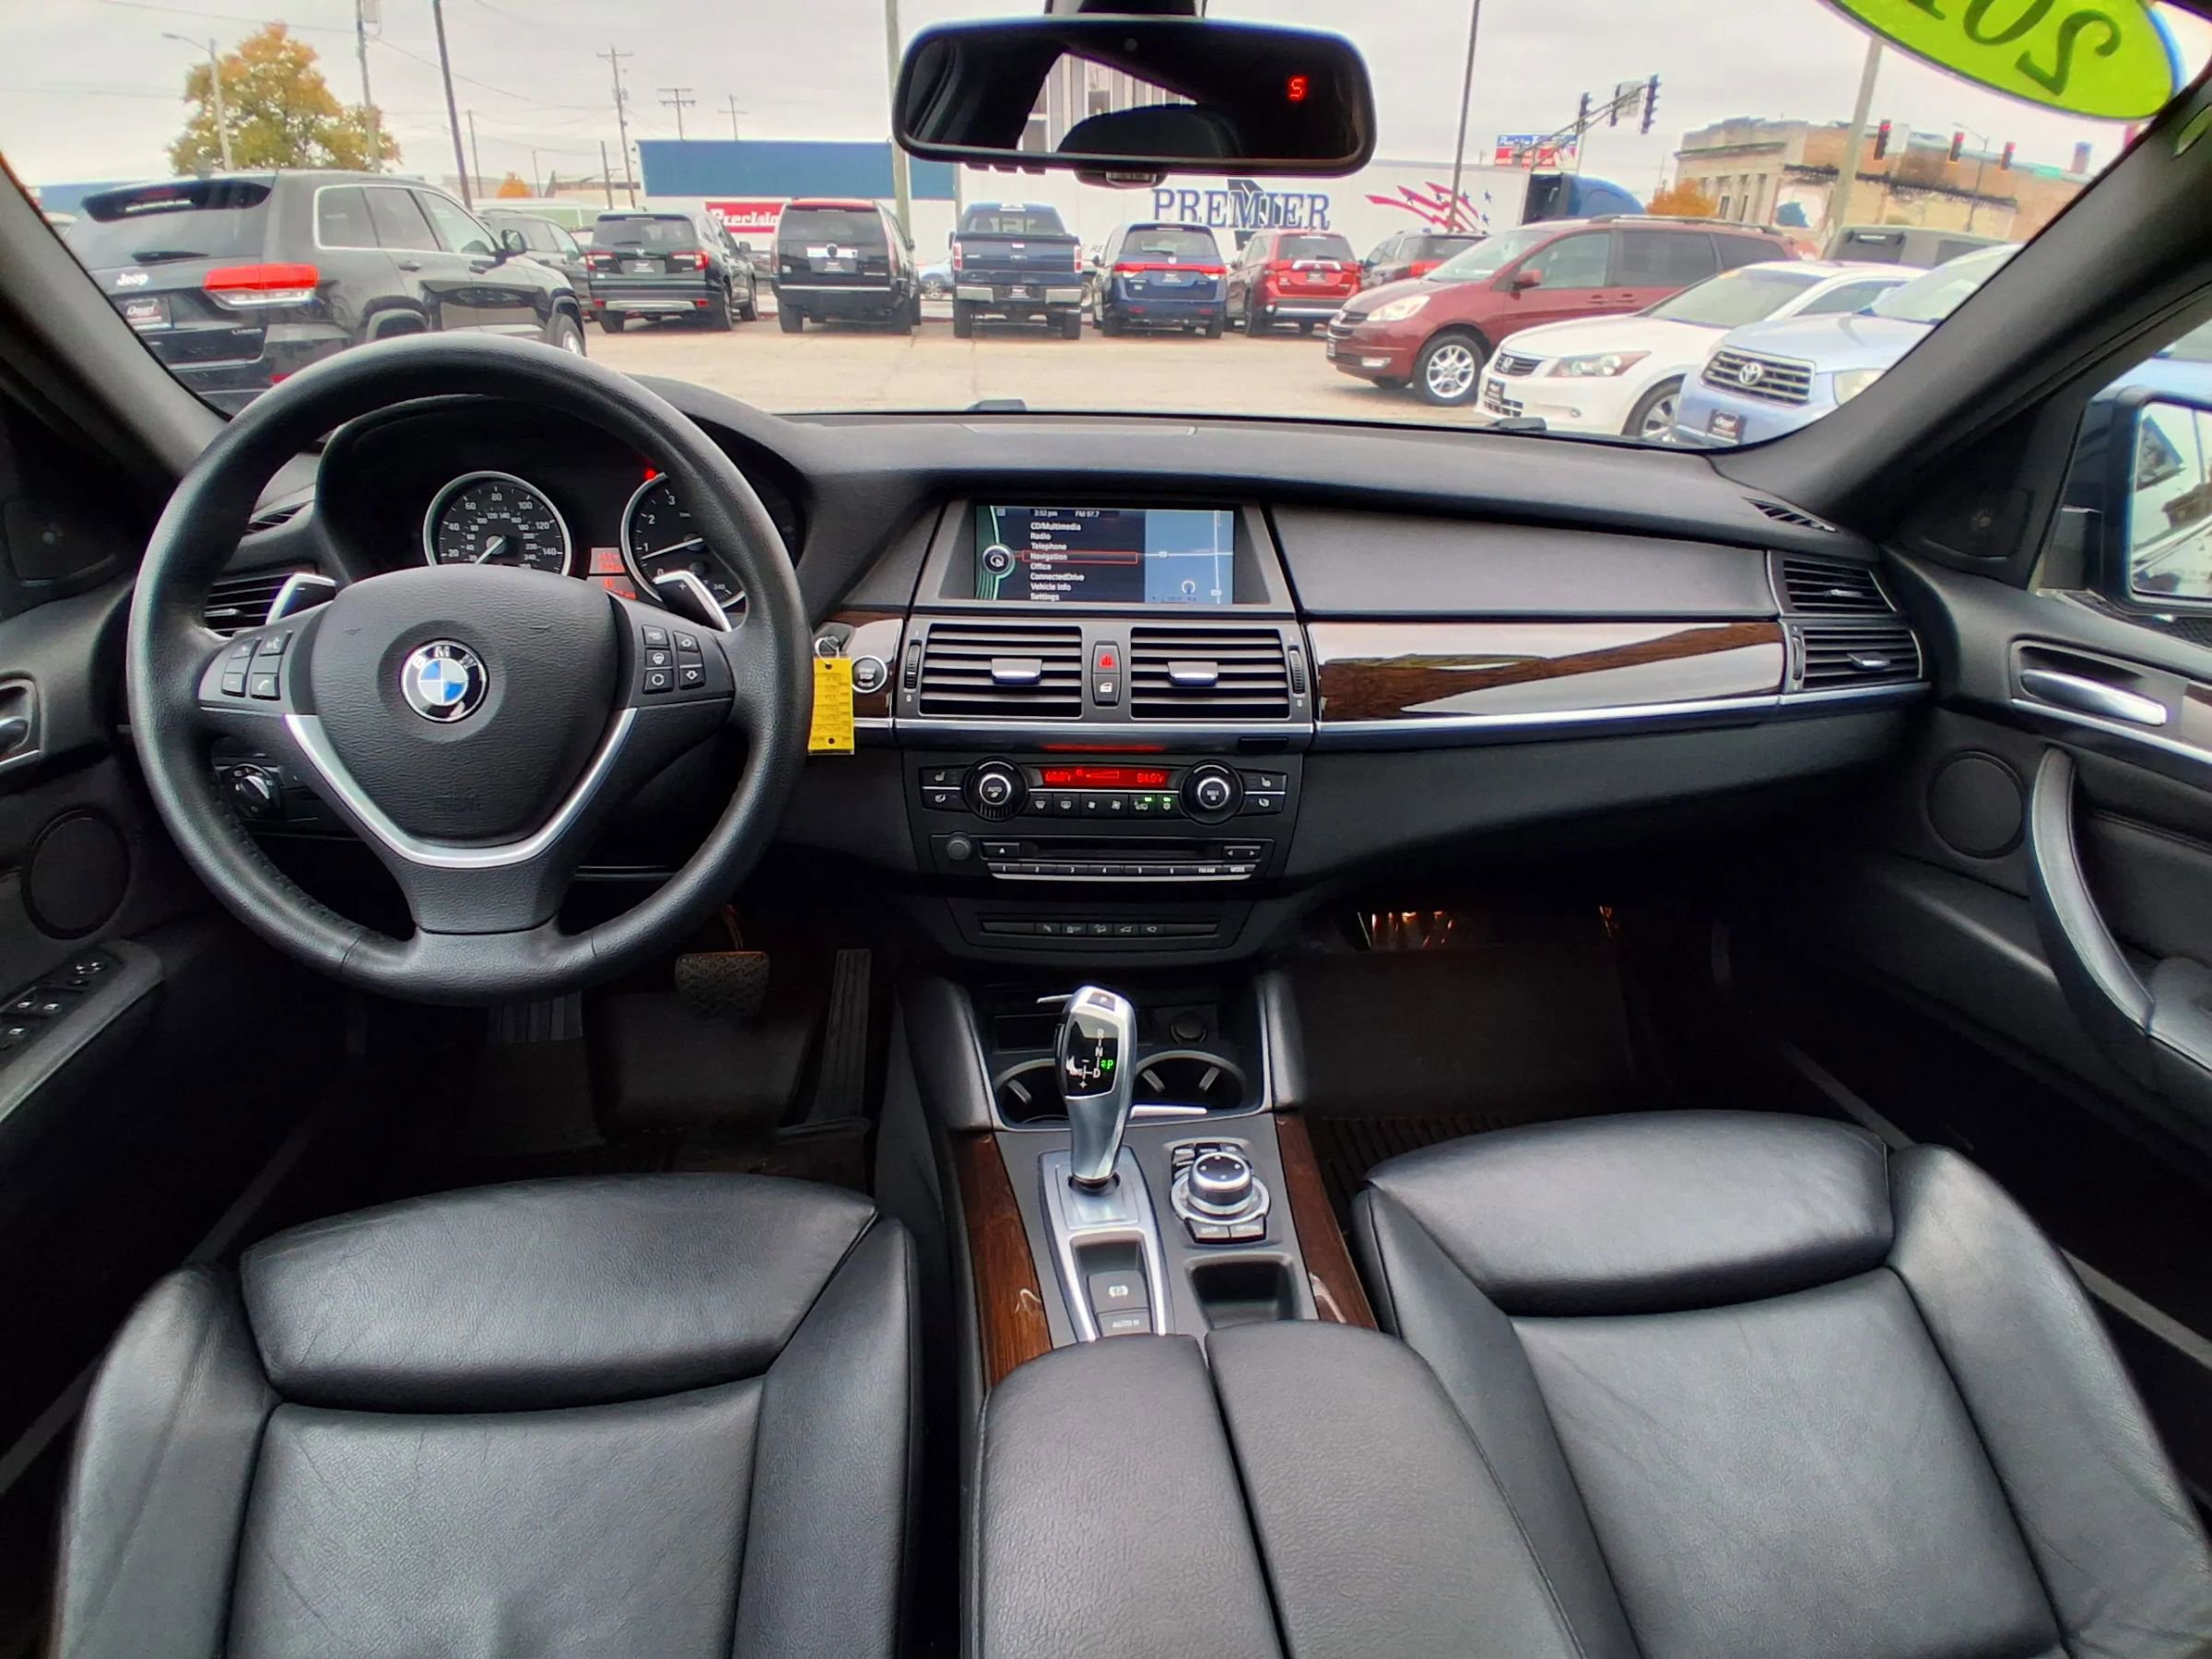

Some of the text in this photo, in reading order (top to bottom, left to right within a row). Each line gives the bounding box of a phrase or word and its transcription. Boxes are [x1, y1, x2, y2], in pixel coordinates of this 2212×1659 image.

[1153, 188, 1331, 230] PREMIER
[116, 274, 149, 288] Jeep
[491, 492, 502, 500] 80
[668, 495, 676, 505] 3
[518, 501, 533, 510] 100
[648, 514, 655, 524] 2
[448, 523, 460, 531] 40
[535, 522, 550, 530] 120
[1030, 522, 1082, 531] CD/Multimedia
[1030, 532, 1052, 540] Radio
[643, 543, 649, 551] 1
[1030, 542, 1067, 550] Telephone
[448, 549, 459, 558] 20
[542, 547, 557, 556] 140
[1030, 552, 1067, 561] Navigation
[1030, 562, 1052, 571] Office
[1030, 572, 1085, 581] ConnectedDrive
[1030, 582, 1056, 591] Vehicle
[1030, 593, 1060, 601] Settings
[411, 646, 477, 669] BMW
[1097, 1028, 1105, 1039] R
[1095, 1046, 1103, 1057] N
[1092, 1067, 1101, 1078] D
